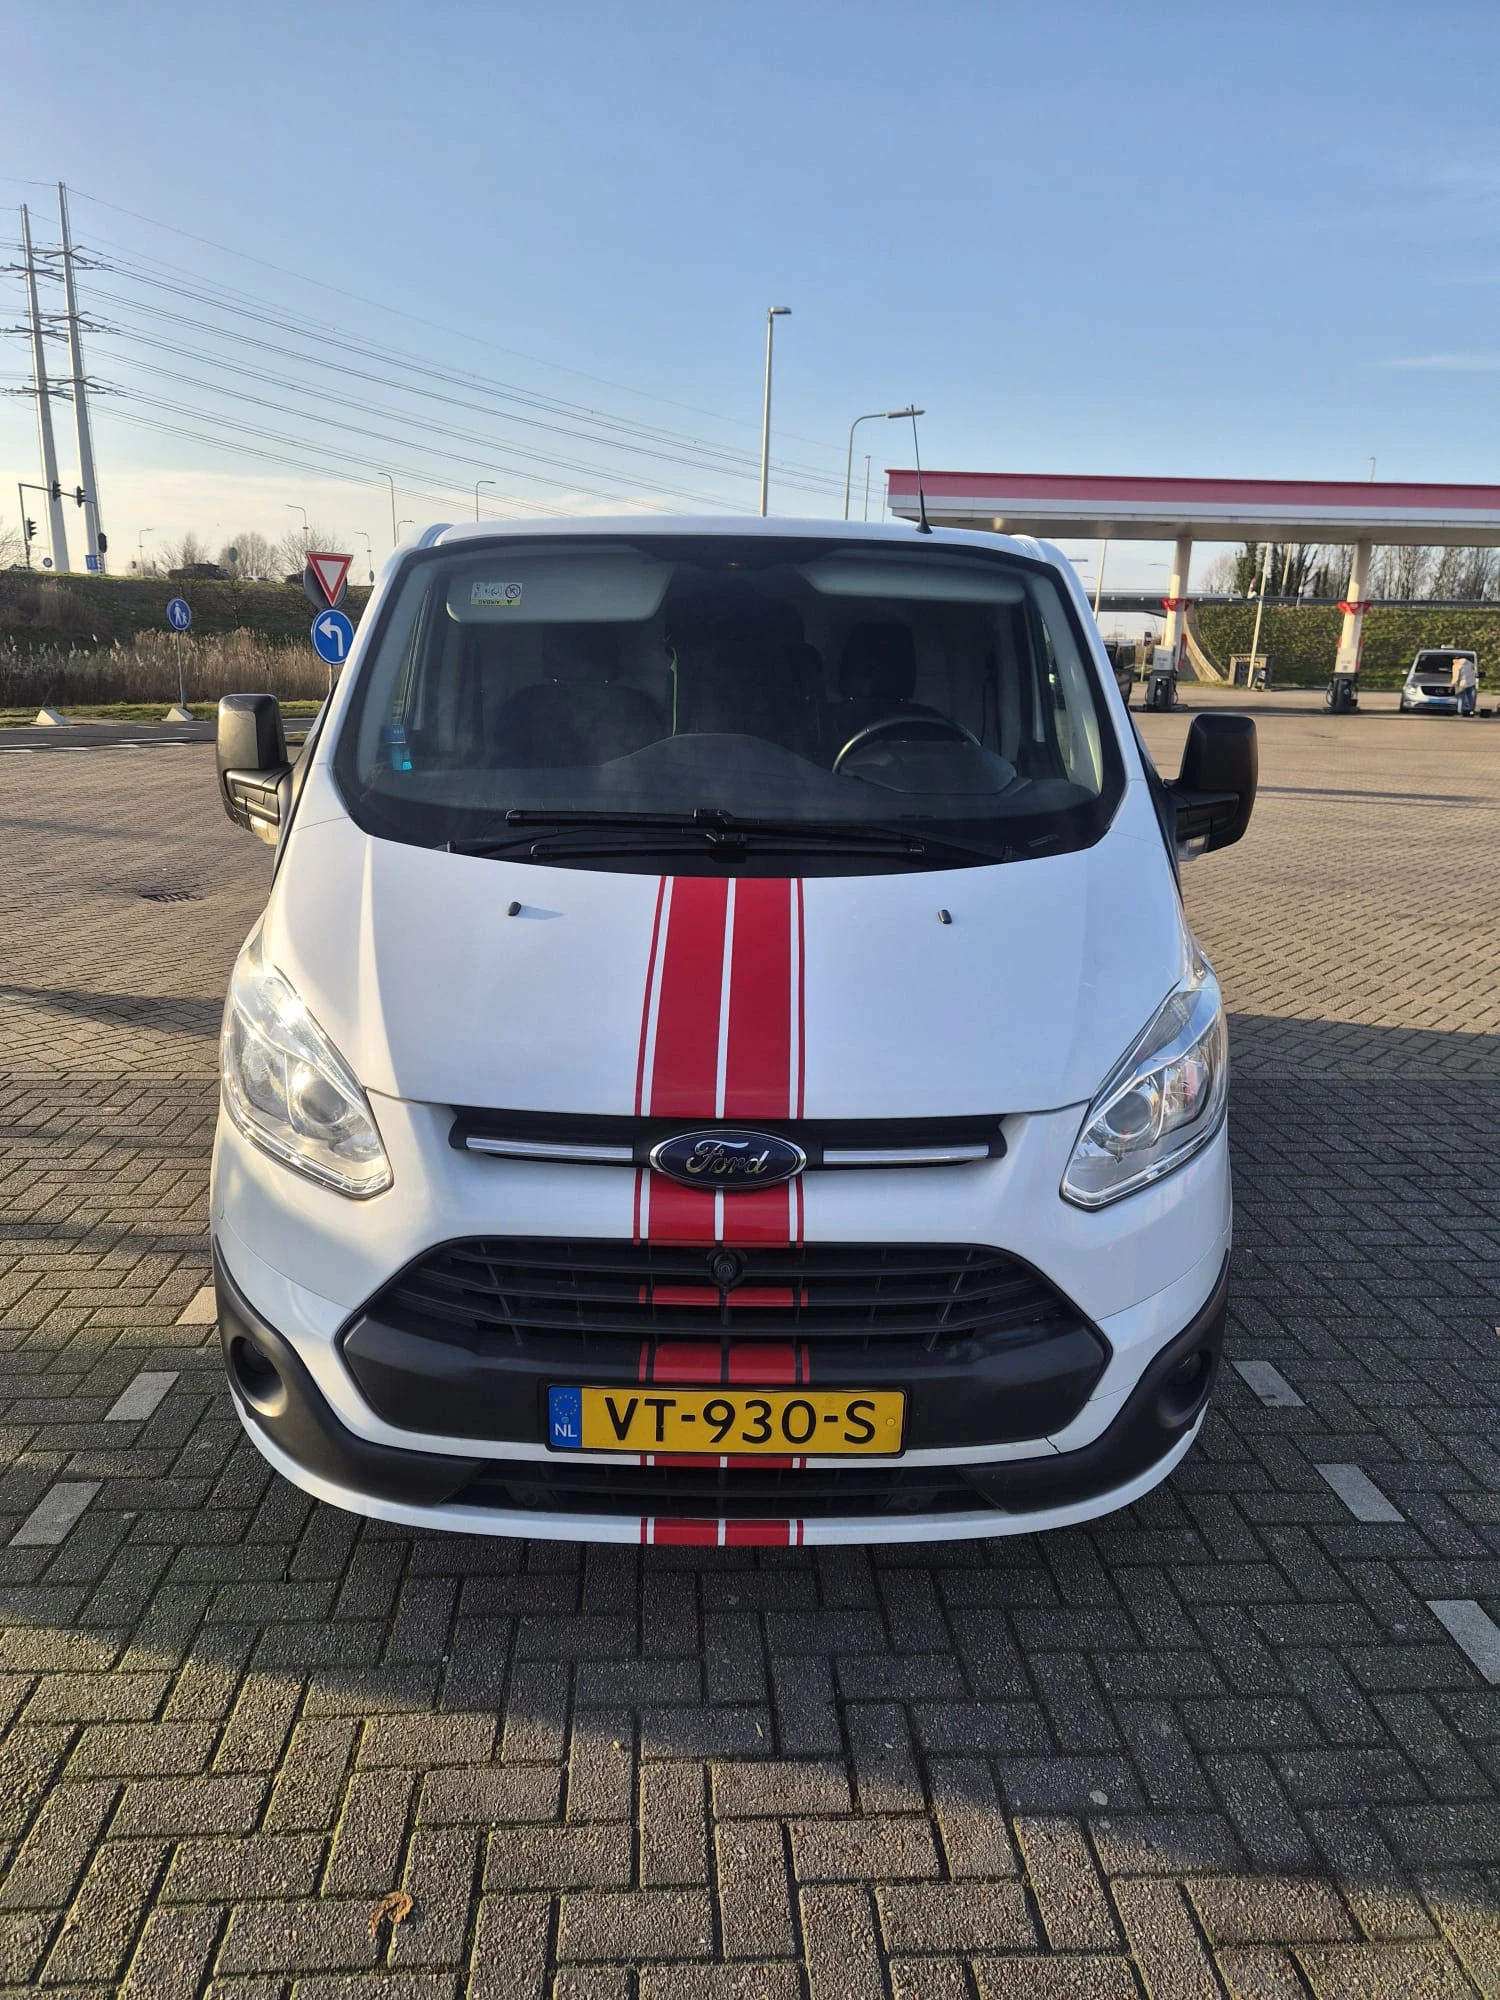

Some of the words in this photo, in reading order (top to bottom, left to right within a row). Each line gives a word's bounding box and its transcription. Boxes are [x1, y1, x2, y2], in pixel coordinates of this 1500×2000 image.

[685, 1139, 770, 1174] Ford
[554, 1423, 578, 1438] NL
[604, 1396, 876, 1444] VT-930-S
